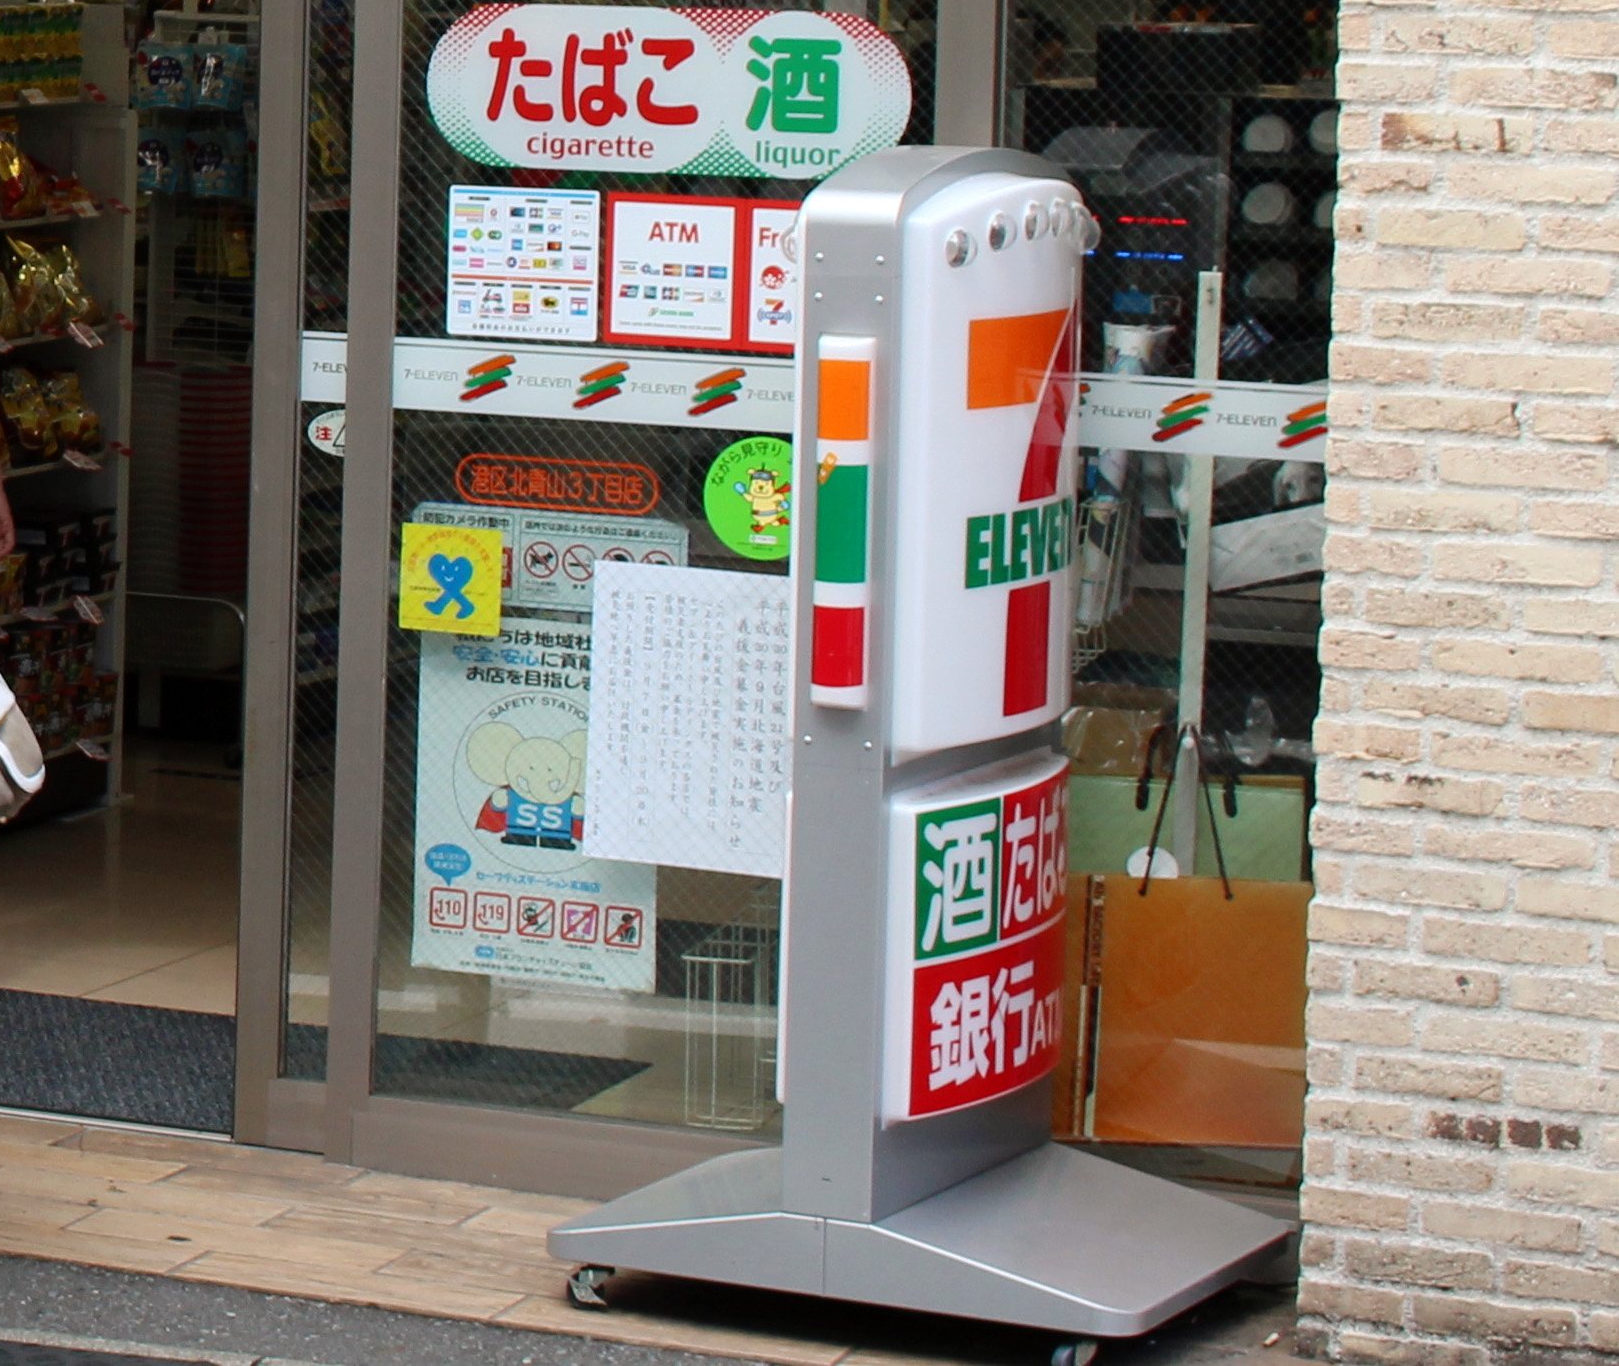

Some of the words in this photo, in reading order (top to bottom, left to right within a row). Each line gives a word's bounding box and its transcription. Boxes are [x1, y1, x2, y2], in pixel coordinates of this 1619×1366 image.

[486, 26, 699, 127] たばこ
[744, 34, 843, 135] 酒
[525, 132, 655, 159] cigarette
[754, 139, 842, 170] liquor
[647, 220, 700, 245] ATM
[470, 463, 644, 505] 港区北青山3丁目店
[422, 511, 510, 529] 防犯カメラ作動中
[487, 696, 536, 720] SAFETY
[515, 802, 564, 829] SS
[921, 811, 998, 952] 酒
[436, 898, 462, 916] 110
[482, 904, 505, 921] 119
